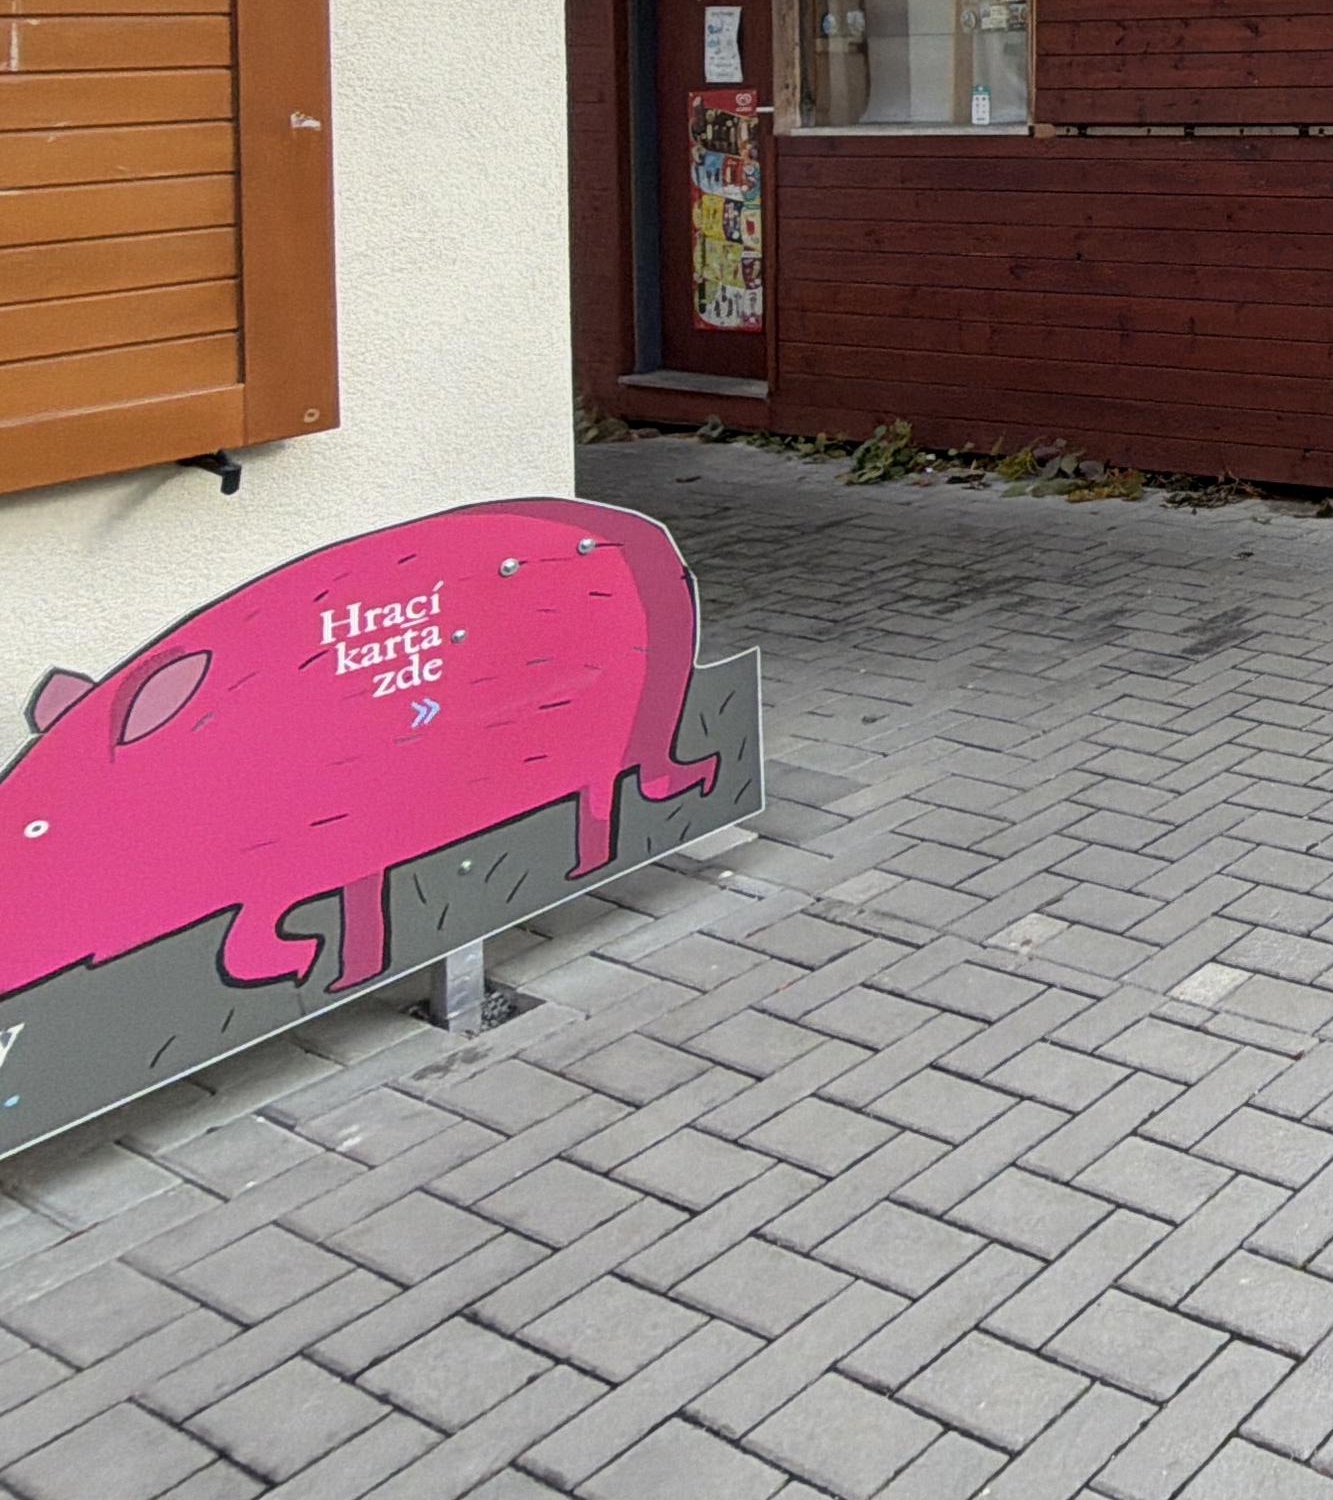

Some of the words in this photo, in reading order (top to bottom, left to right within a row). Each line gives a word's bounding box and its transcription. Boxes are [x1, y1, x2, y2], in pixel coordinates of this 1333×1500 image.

[319, 580, 445, 646] Hrací
[335, 625, 442, 676] karta
[372, 653, 444, 698] zde
